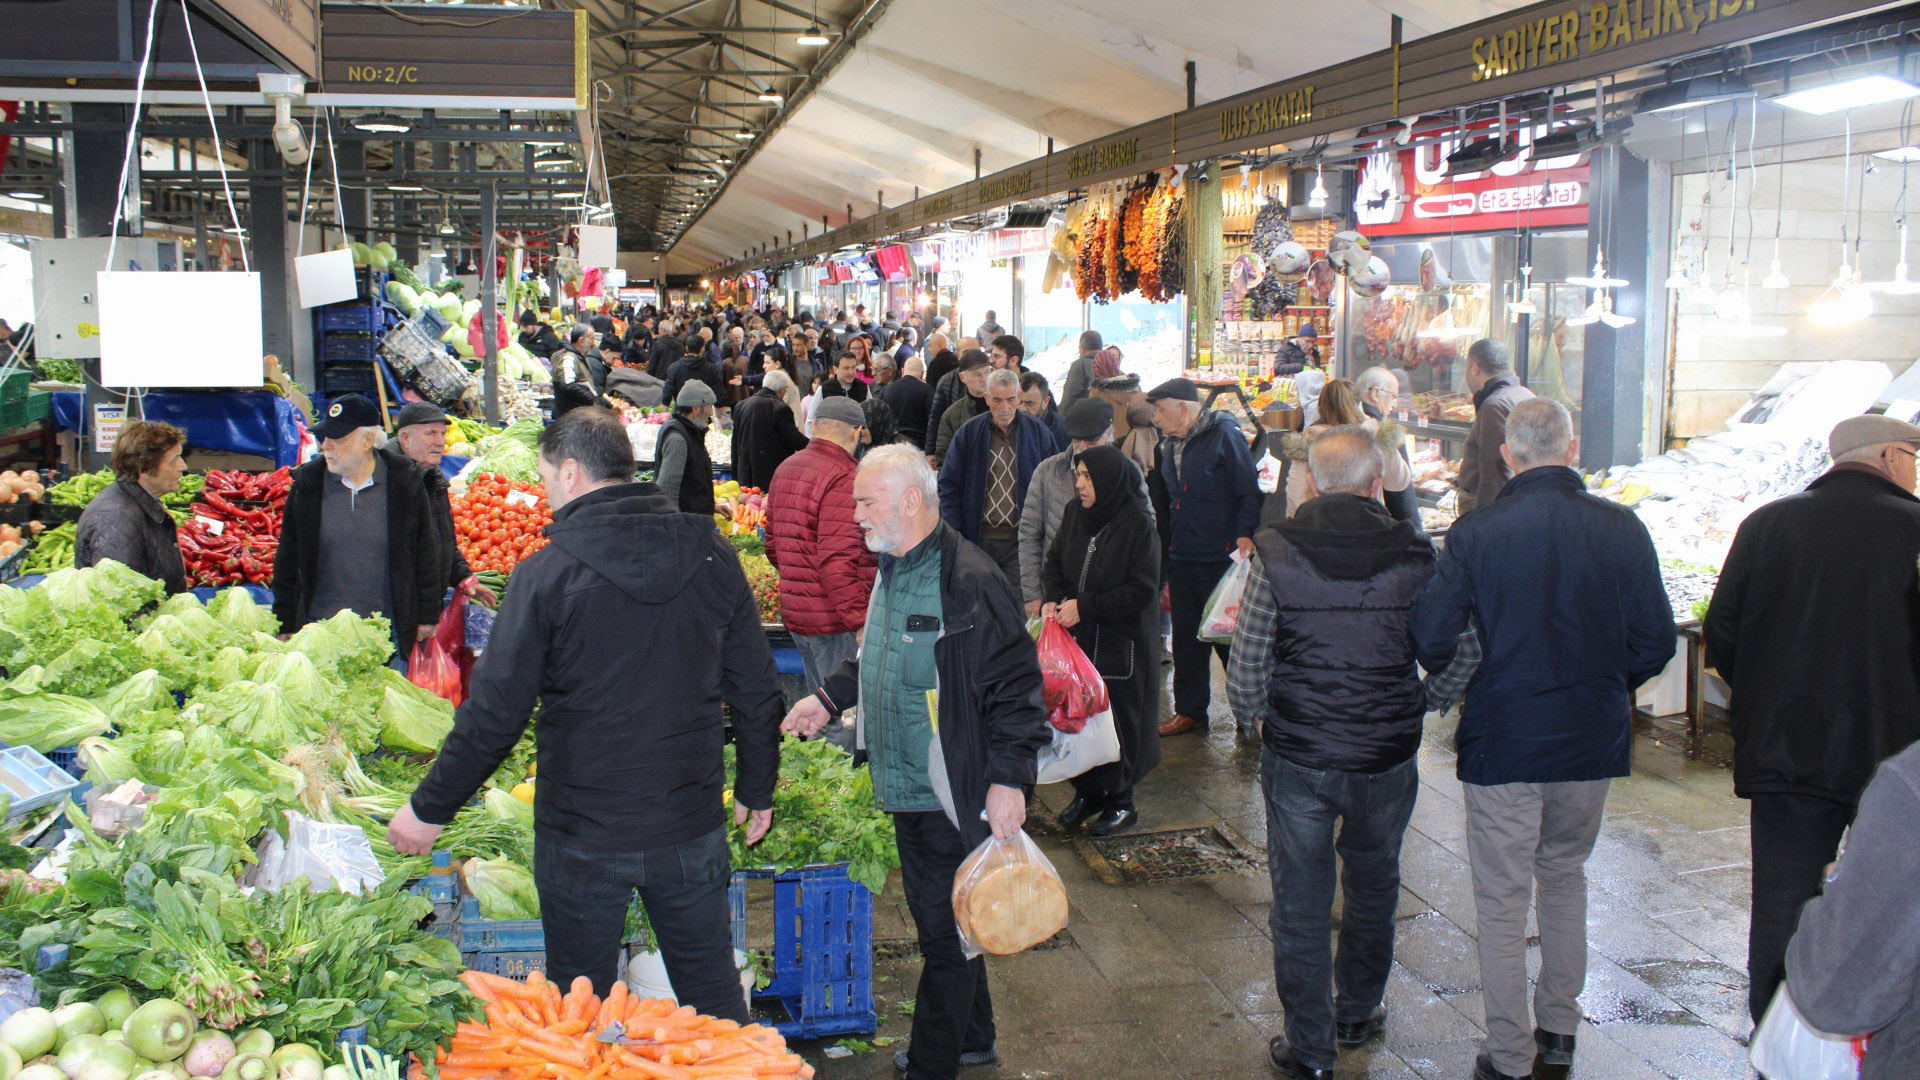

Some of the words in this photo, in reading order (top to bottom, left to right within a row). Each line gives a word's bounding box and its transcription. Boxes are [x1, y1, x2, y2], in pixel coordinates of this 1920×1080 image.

[1472, 9, 1580, 82] SARIYER
[1590, 0, 1755, 50] BALIKÇ
[348, 64, 418, 84] NO:2/C
[1220, 104, 1251, 140] ULUS
[1252, 86, 1315, 134] SAKATAT
[1099, 137, 1137, 172] BAHARAT
[1482, 193, 1496, 209] Et
